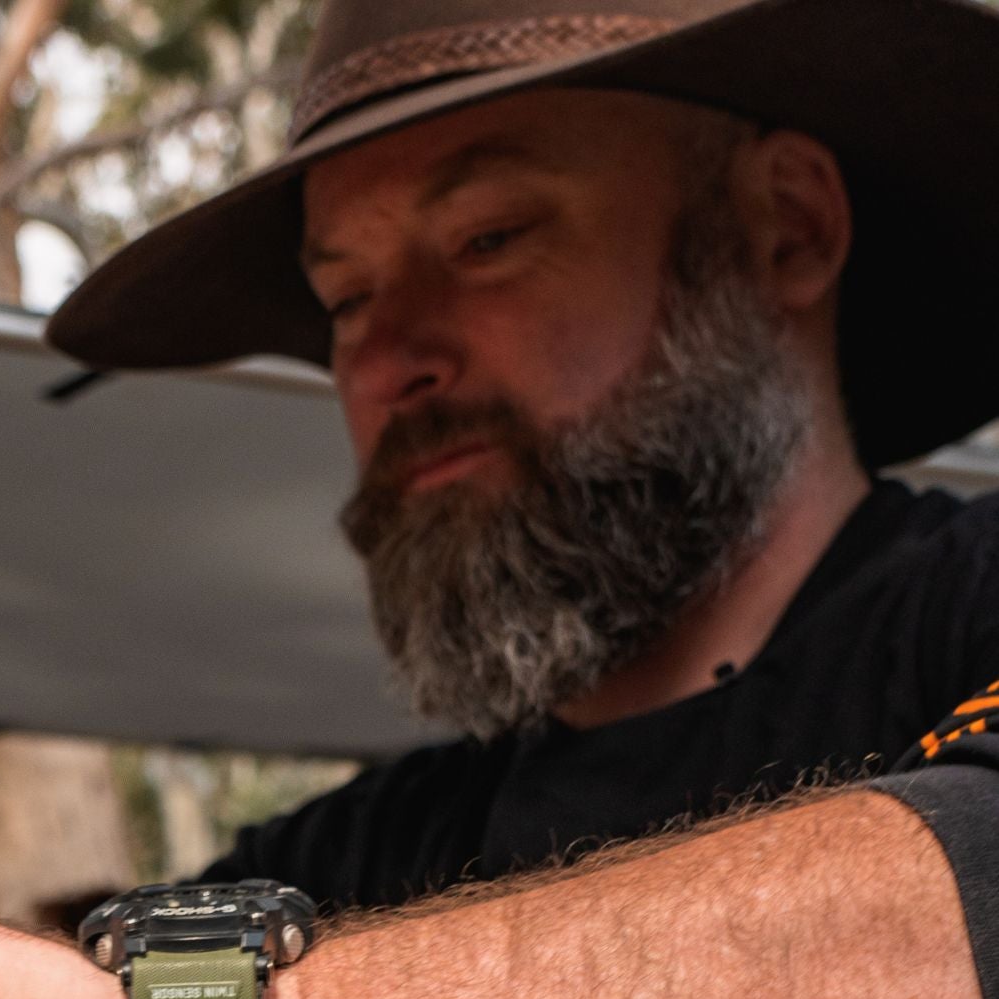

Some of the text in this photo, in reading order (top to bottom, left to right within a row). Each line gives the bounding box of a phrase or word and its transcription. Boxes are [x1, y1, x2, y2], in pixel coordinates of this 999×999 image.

[151, 904, 237, 916] G-SHOCK
[151, 985, 236, 999] TWIN SENSOR
